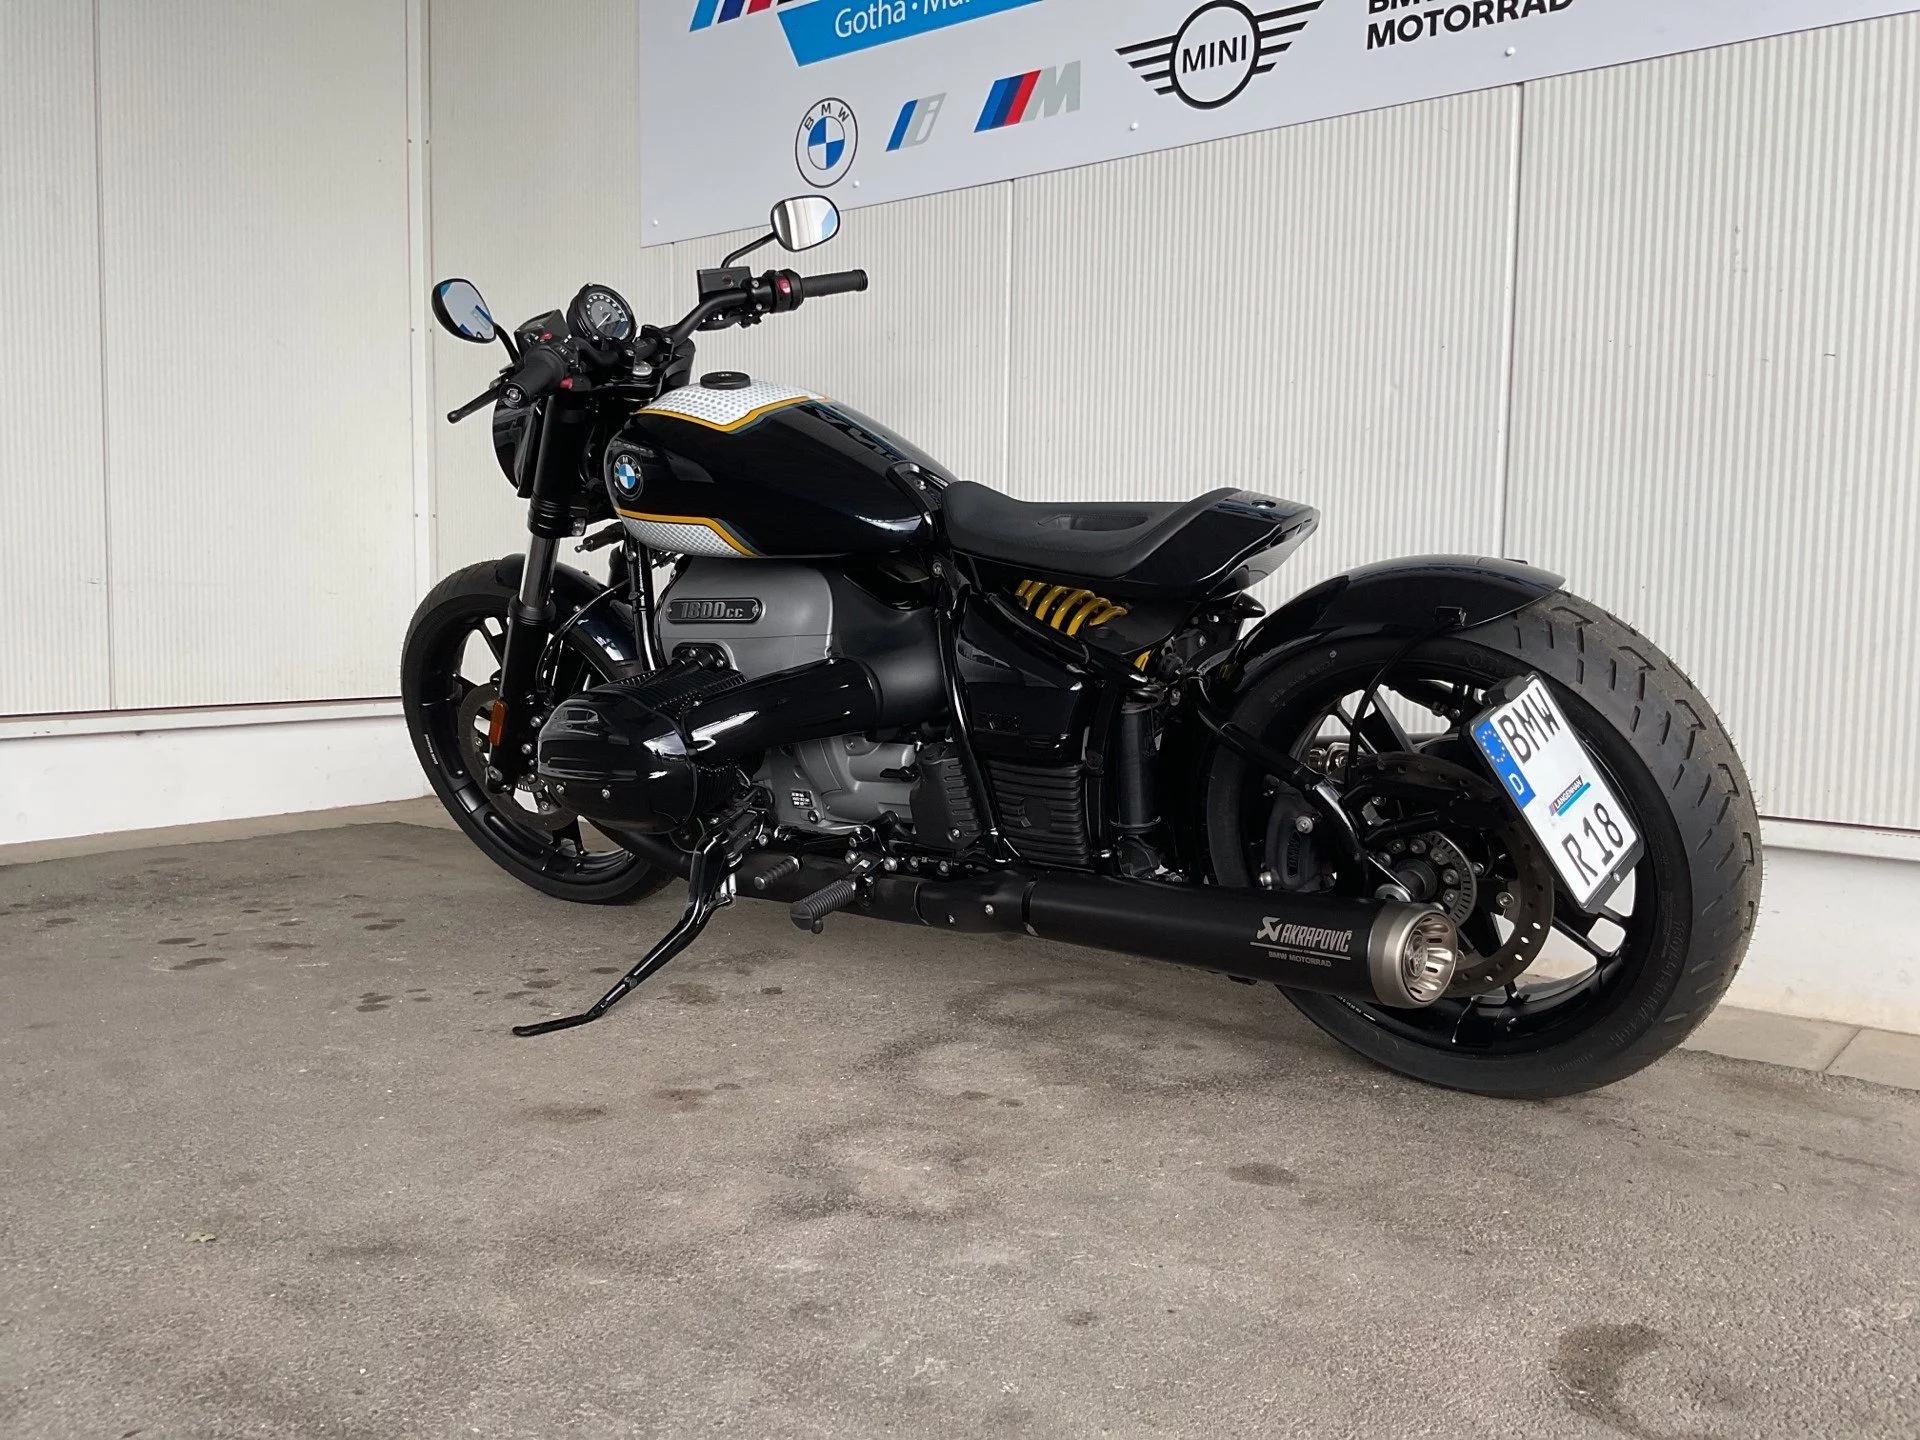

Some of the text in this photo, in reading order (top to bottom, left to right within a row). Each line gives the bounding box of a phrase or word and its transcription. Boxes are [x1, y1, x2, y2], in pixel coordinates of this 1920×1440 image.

[834, 0, 905, 38] Gotha
[1182, 34, 1248, 74] MINI
[804, 102, 850, 130] BMW
[615, 457, 638, 470] BMW
[681, 602, 744, 619] 1800cc
[1498, 686, 1561, 765] BMW
[1508, 773, 1525, 795] D
[1553, 778, 1582, 810] LANGENHAN
[1561, 802, 1624, 886] R 18
[1268, 951, 1332, 967] BMW MOTORRAD
